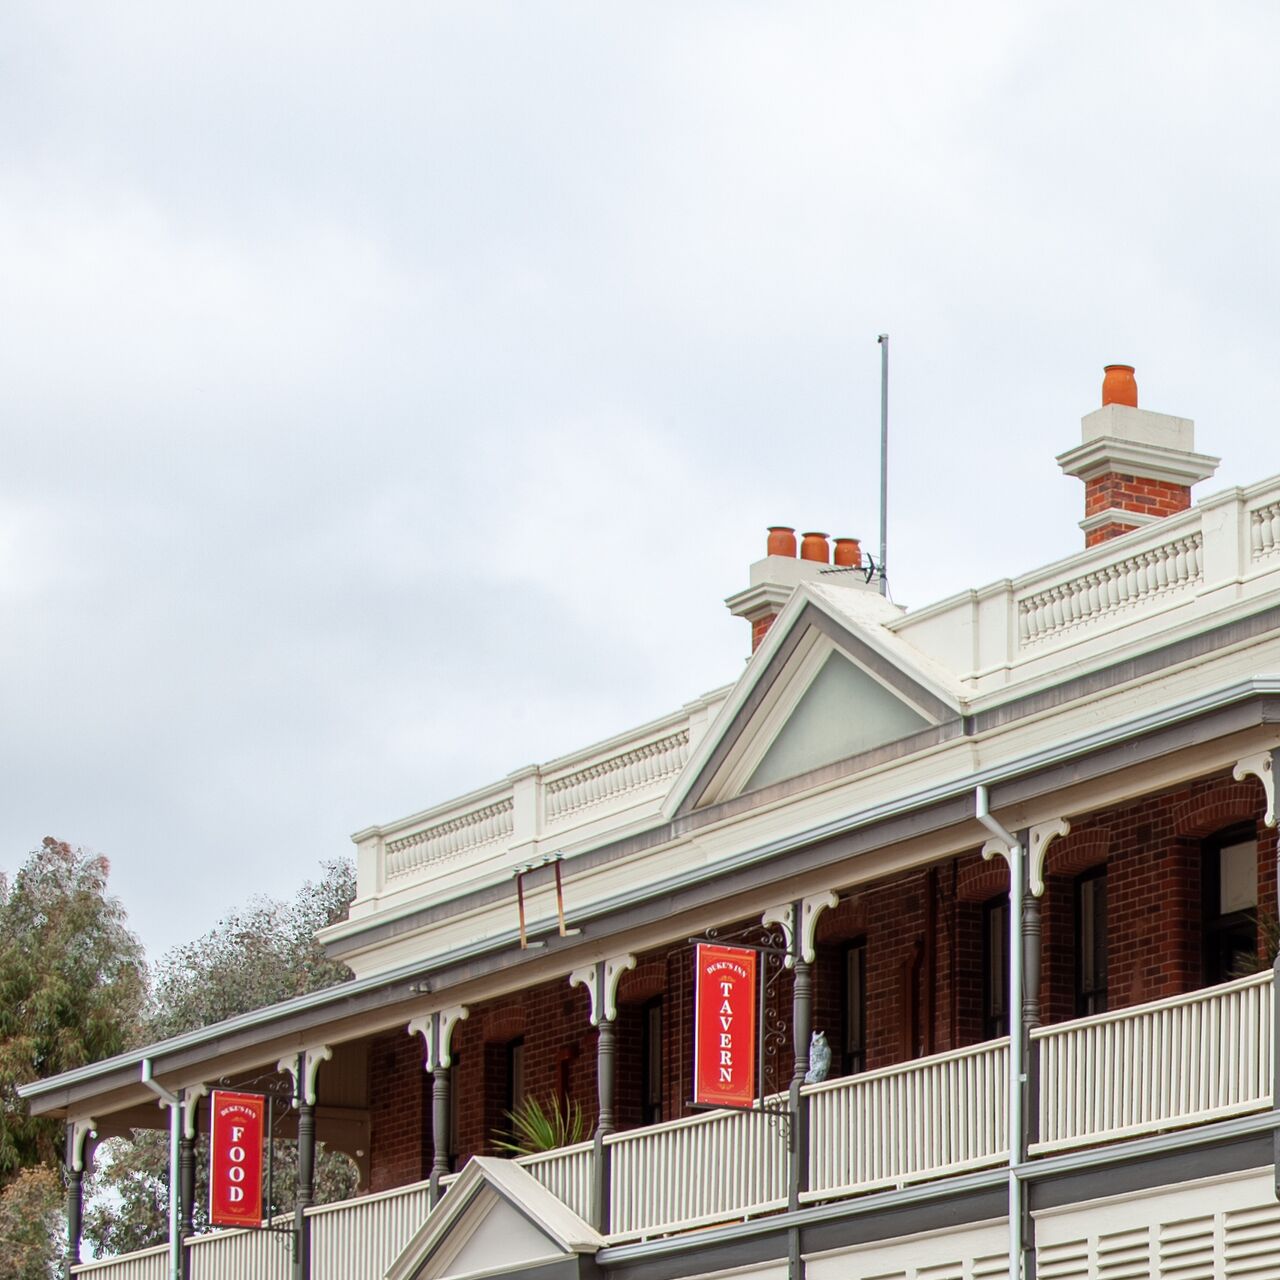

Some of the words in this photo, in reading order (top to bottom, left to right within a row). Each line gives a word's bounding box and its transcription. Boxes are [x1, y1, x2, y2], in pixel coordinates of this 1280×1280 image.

[707, 962, 733, 975] DUKE'S
[733, 965, 747, 978] INN
[719, 982, 733, 1082] TAVERN
[229, 1126, 245, 1202] FOOD
